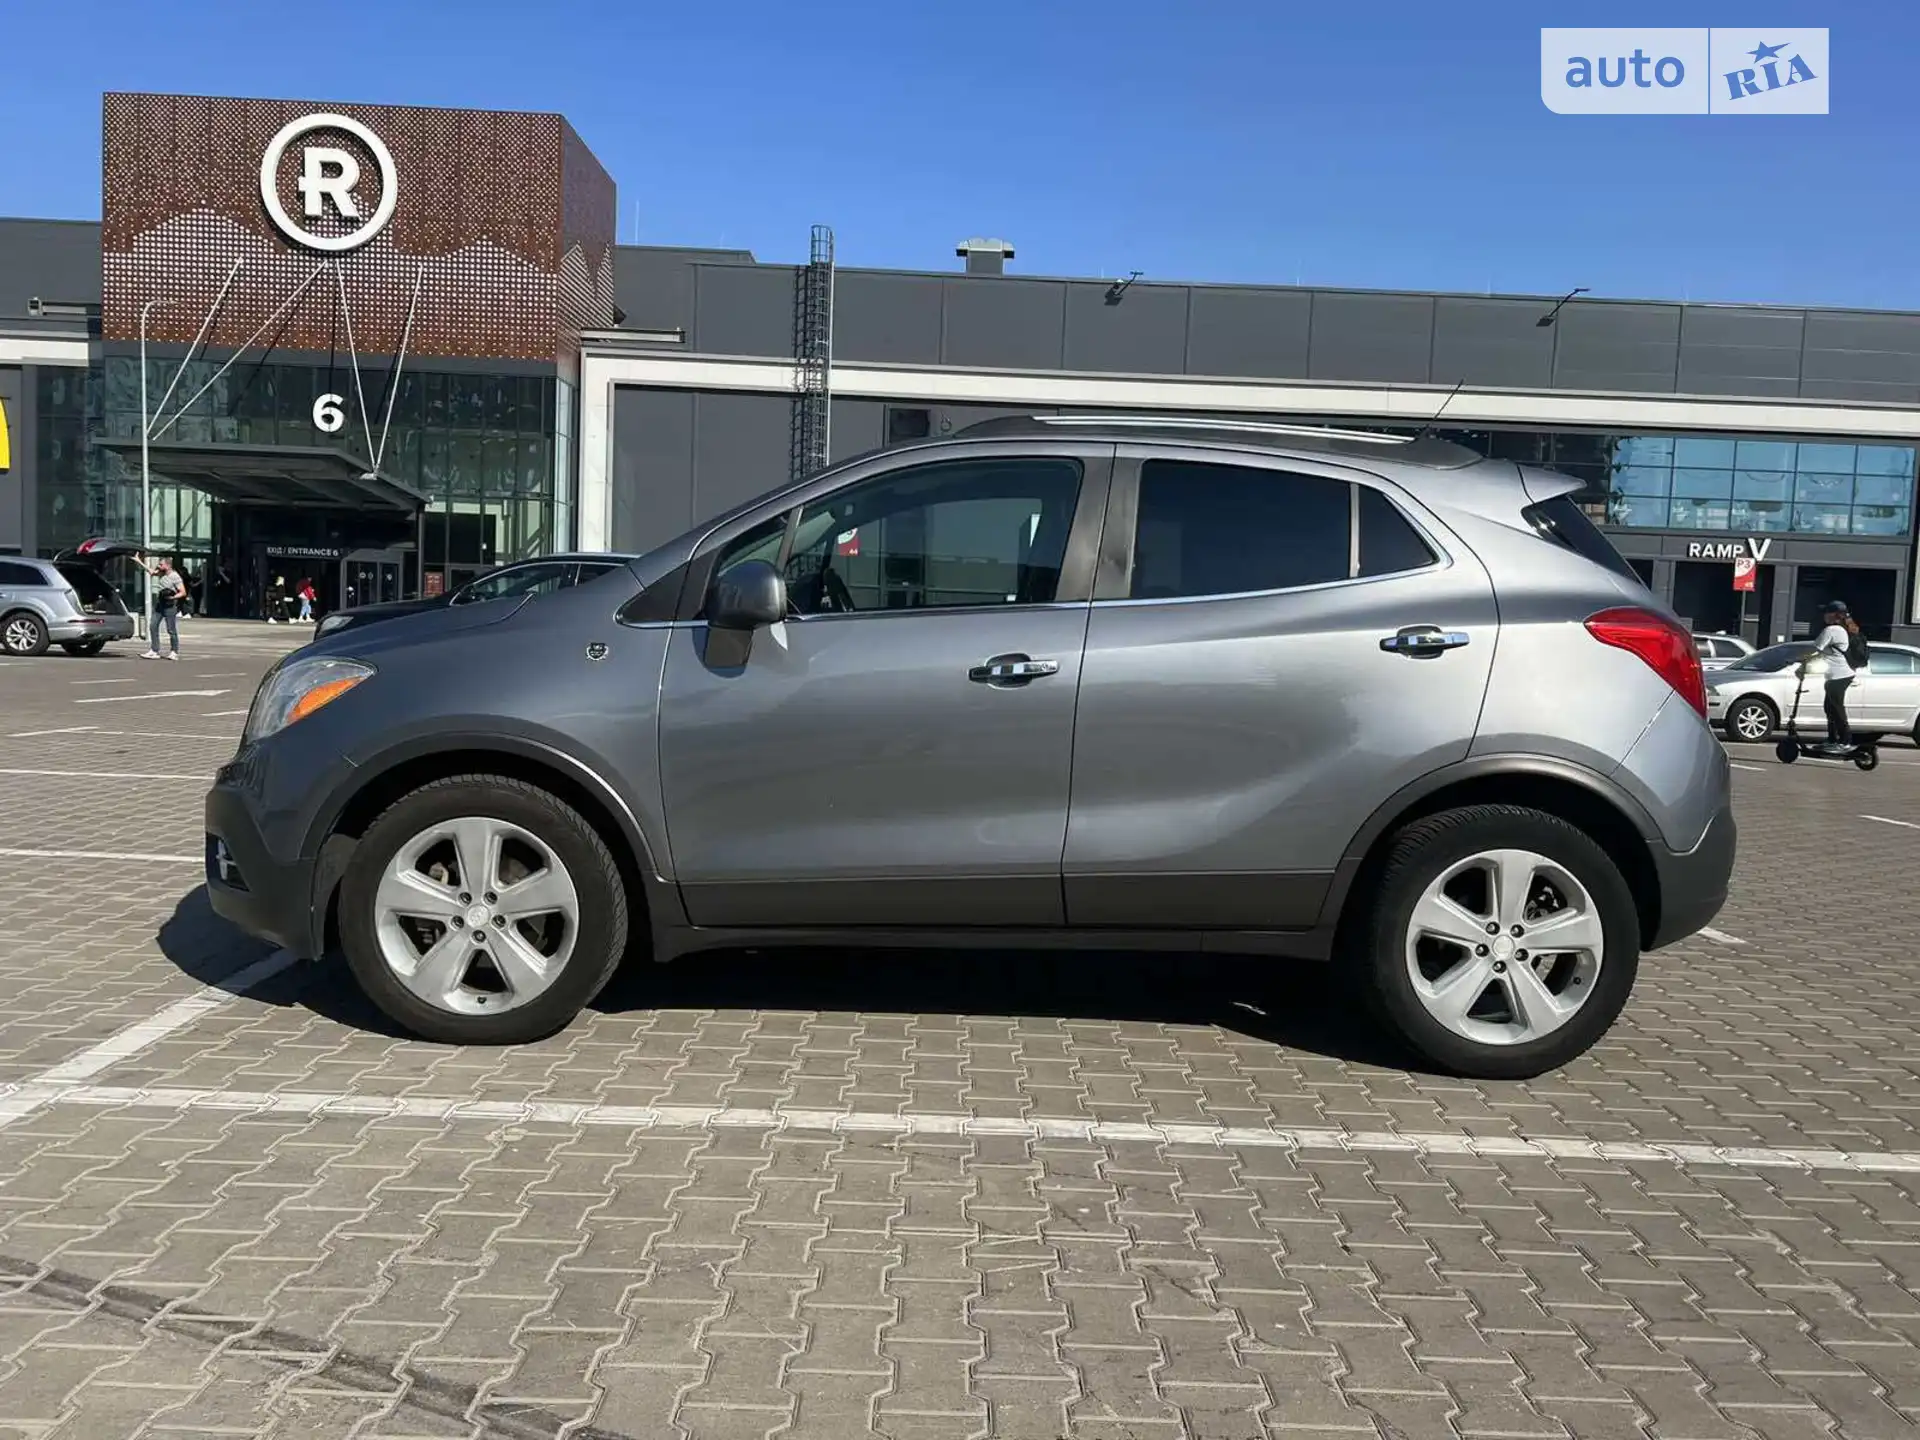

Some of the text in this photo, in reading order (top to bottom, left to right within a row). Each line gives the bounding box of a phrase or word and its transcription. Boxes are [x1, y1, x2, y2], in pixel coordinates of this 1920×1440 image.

[312, 393, 345, 432] 6
[287, 547, 331, 556] ENTRANCE
[1689, 538, 1772, 561] RAMP V
[1737, 560, 1751, 569] P3
